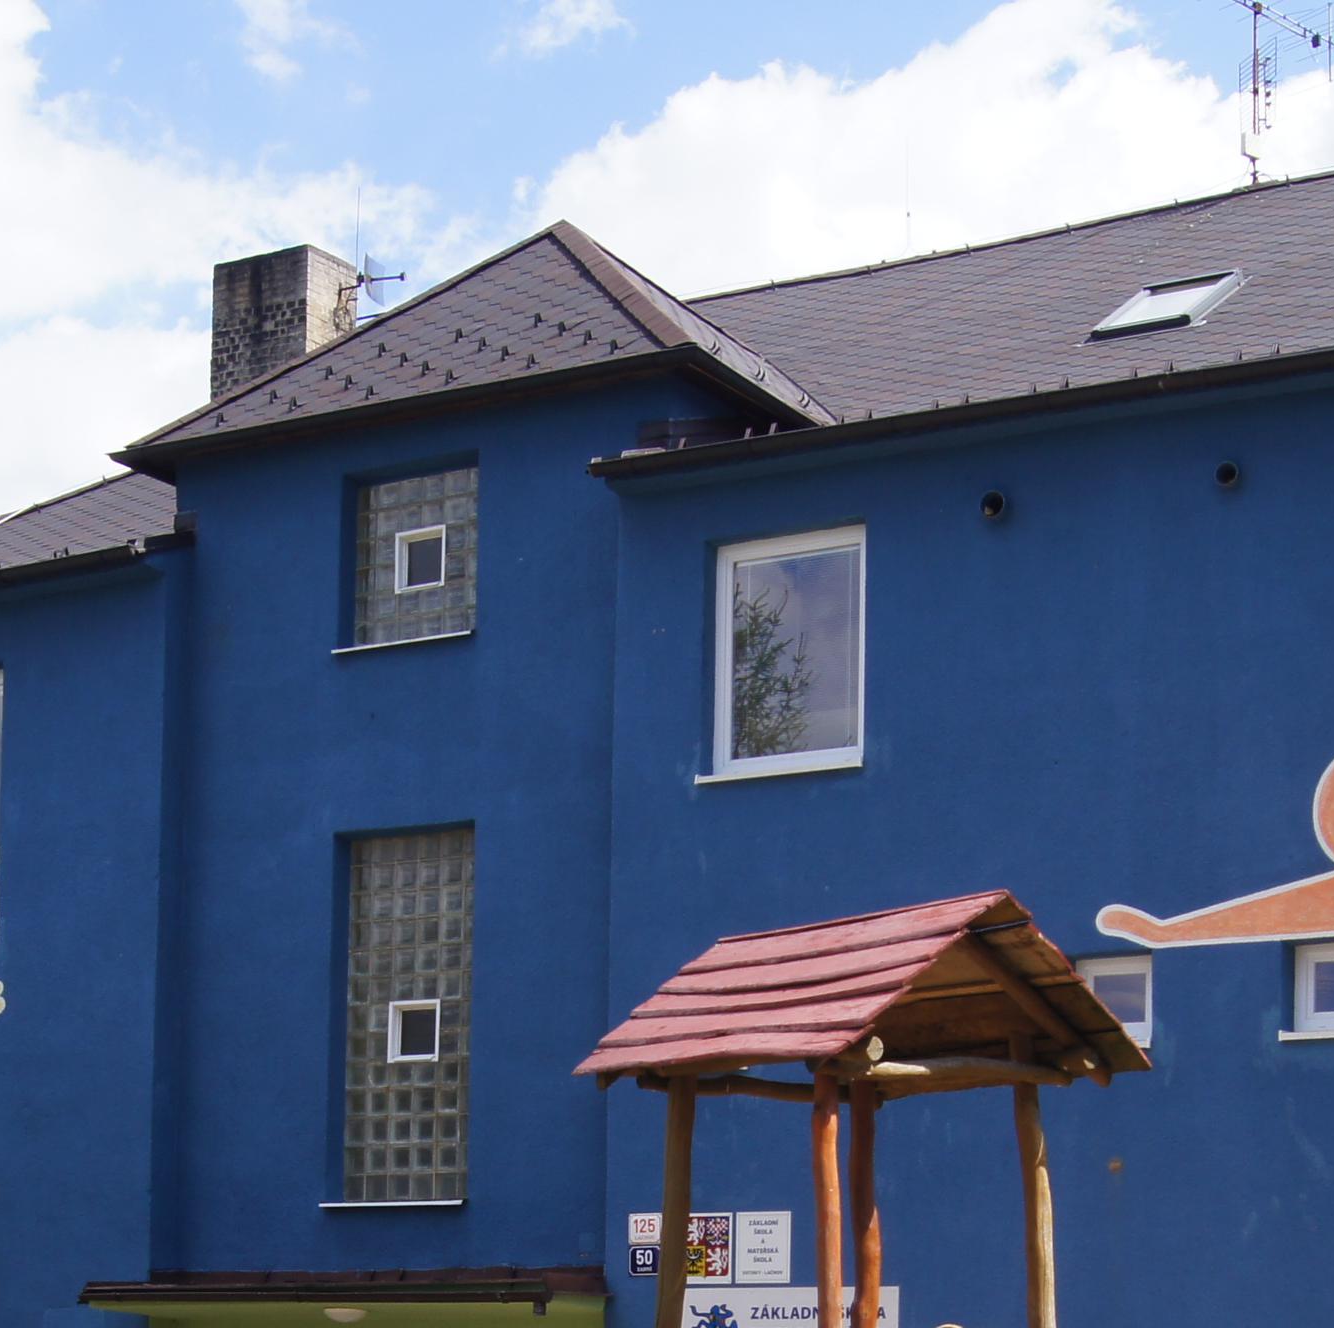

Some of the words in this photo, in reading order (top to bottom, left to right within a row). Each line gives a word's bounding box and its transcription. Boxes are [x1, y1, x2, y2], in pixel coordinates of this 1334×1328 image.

[633, 1218, 656, 1233] 125
[636, 1249, 653, 1265] 50
[750, 1304, 820, 1320] ZÁKLADN
